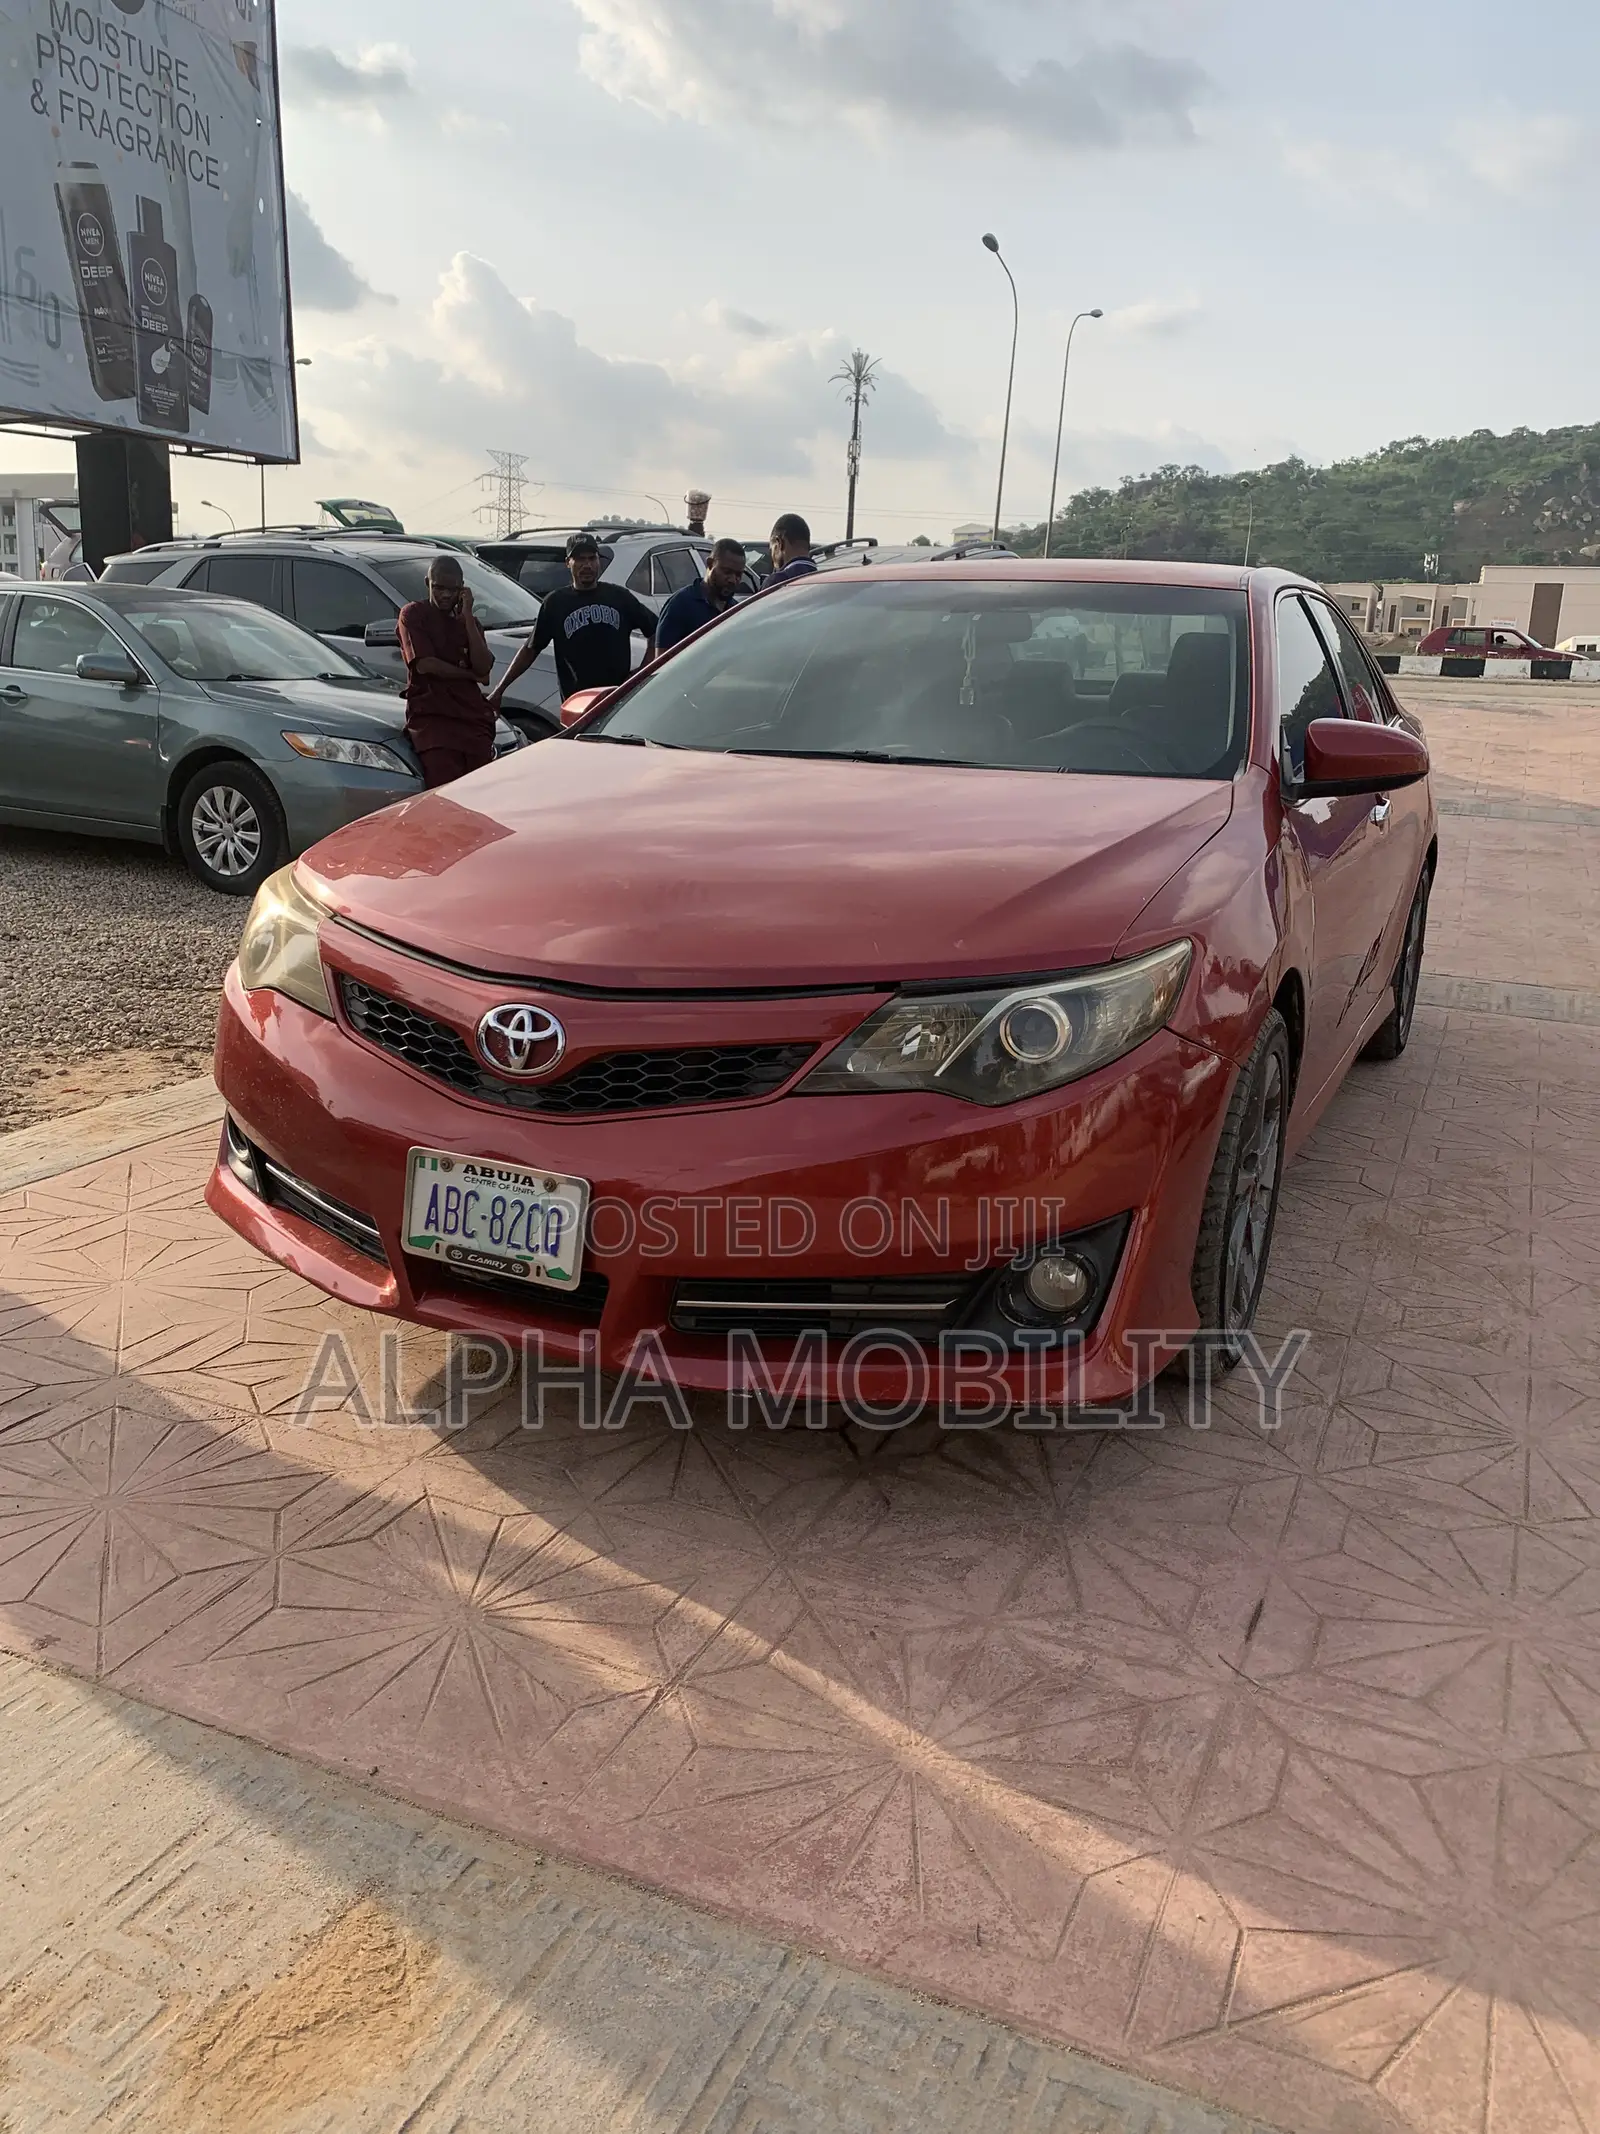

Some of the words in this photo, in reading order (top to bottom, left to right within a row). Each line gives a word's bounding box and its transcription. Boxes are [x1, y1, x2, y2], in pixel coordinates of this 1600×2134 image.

[49, 0, 196, 103] MOISTURE,
[36, 32, 211, 147] PROTECTION
[30, 78, 50, 117] &
[59, 89, 220, 190] FRAGRANCE
[80, 227, 101, 237] NIVEA
[80, 265, 114, 279] DEEP
[144, 271, 165, 287] NIVEA
[147, 283, 163, 295] MEN
[142, 317, 169, 334] DEEP
[564, 604, 621, 640] OXFORD
[462, 1164, 535, 1187] ABUJA
[463, 1176, 497, 1188] CENTRE
[498, 1182, 511, 1190] OF
[512, 1186, 535, 1196] UNITY
